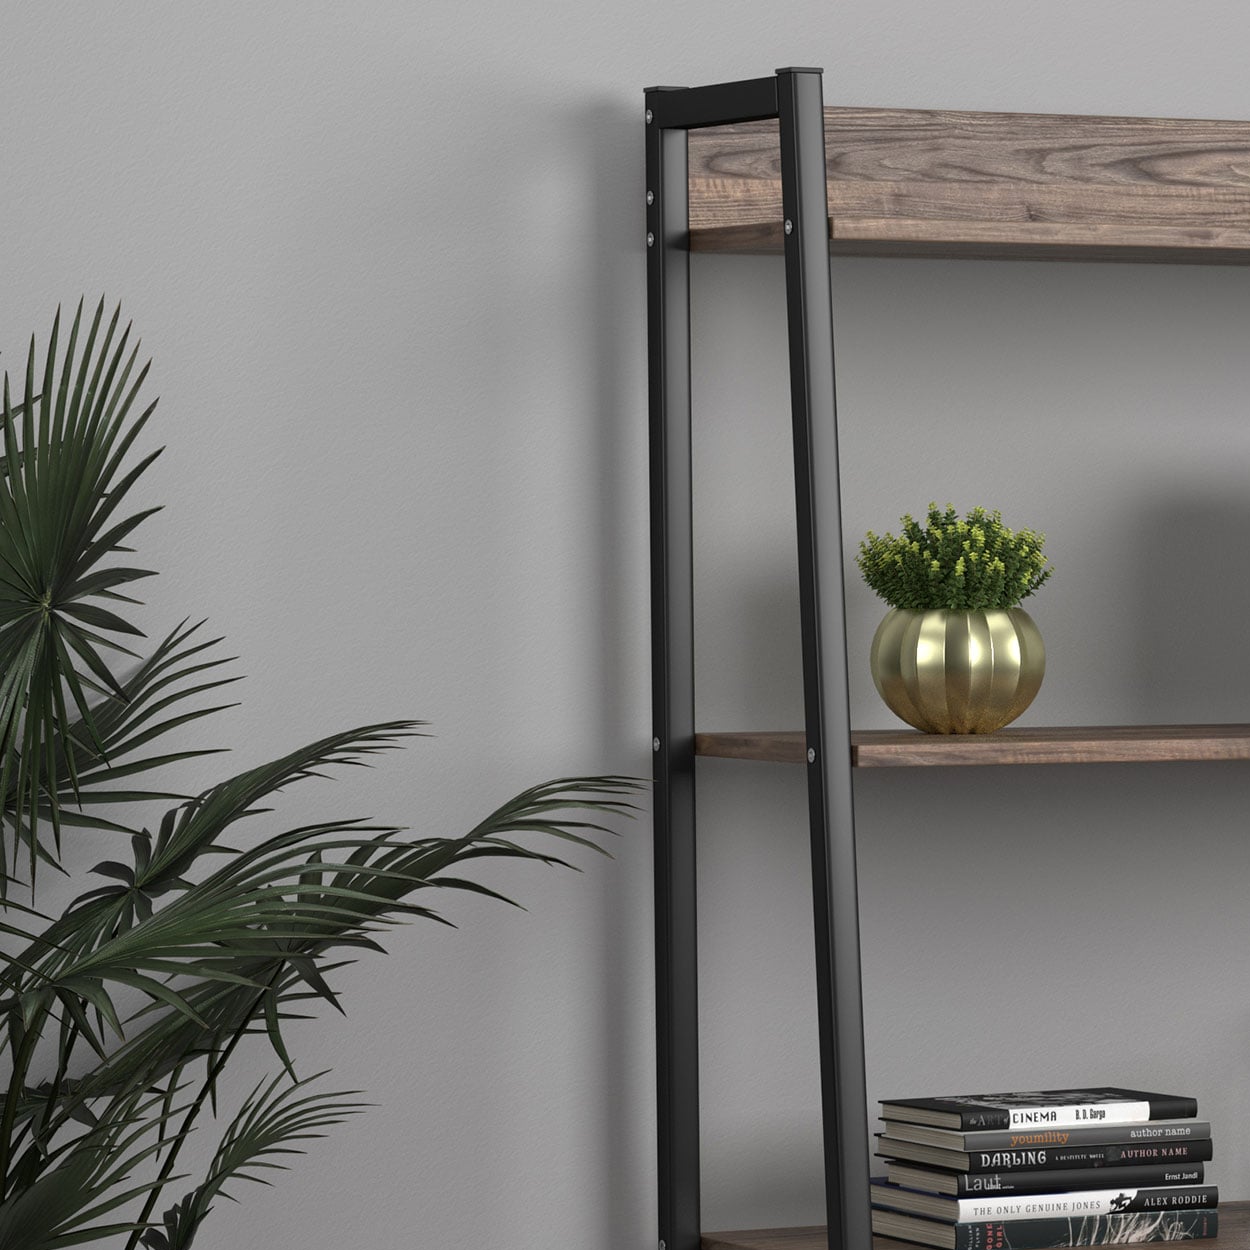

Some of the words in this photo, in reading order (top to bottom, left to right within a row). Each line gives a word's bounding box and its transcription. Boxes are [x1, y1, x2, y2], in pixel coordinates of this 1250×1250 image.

[1012, 1111, 1057, 1125] CINEMA
[1075, 1109, 1081, 1120] B.
[1082, 1109, 1088, 1120] D.
[1089, 1108, 1106, 1120] Garga
[1130, 1128, 1163, 1138] author
[1164, 1127, 1191, 1136] name
[981, 1151, 1047, 1168] DARLING
[1120, 1149, 1158, 1159] AUTHOR
[1161, 1147, 1188, 1157] NAME
[1165, 1173, 1180, 1181] Ernst
[1181, 1171, 1198, 1180] Jandl
[974, 1207, 992, 1216] THE
[996, 1205, 1022, 1215] ONLY
[1025, 1202, 1068, 1213] GENUINE
[1071, 1200, 1101, 1212] JONES
[1144, 1198, 1168, 1207] ALEX
[1171, 1194, 1208, 1205] RODDIE
